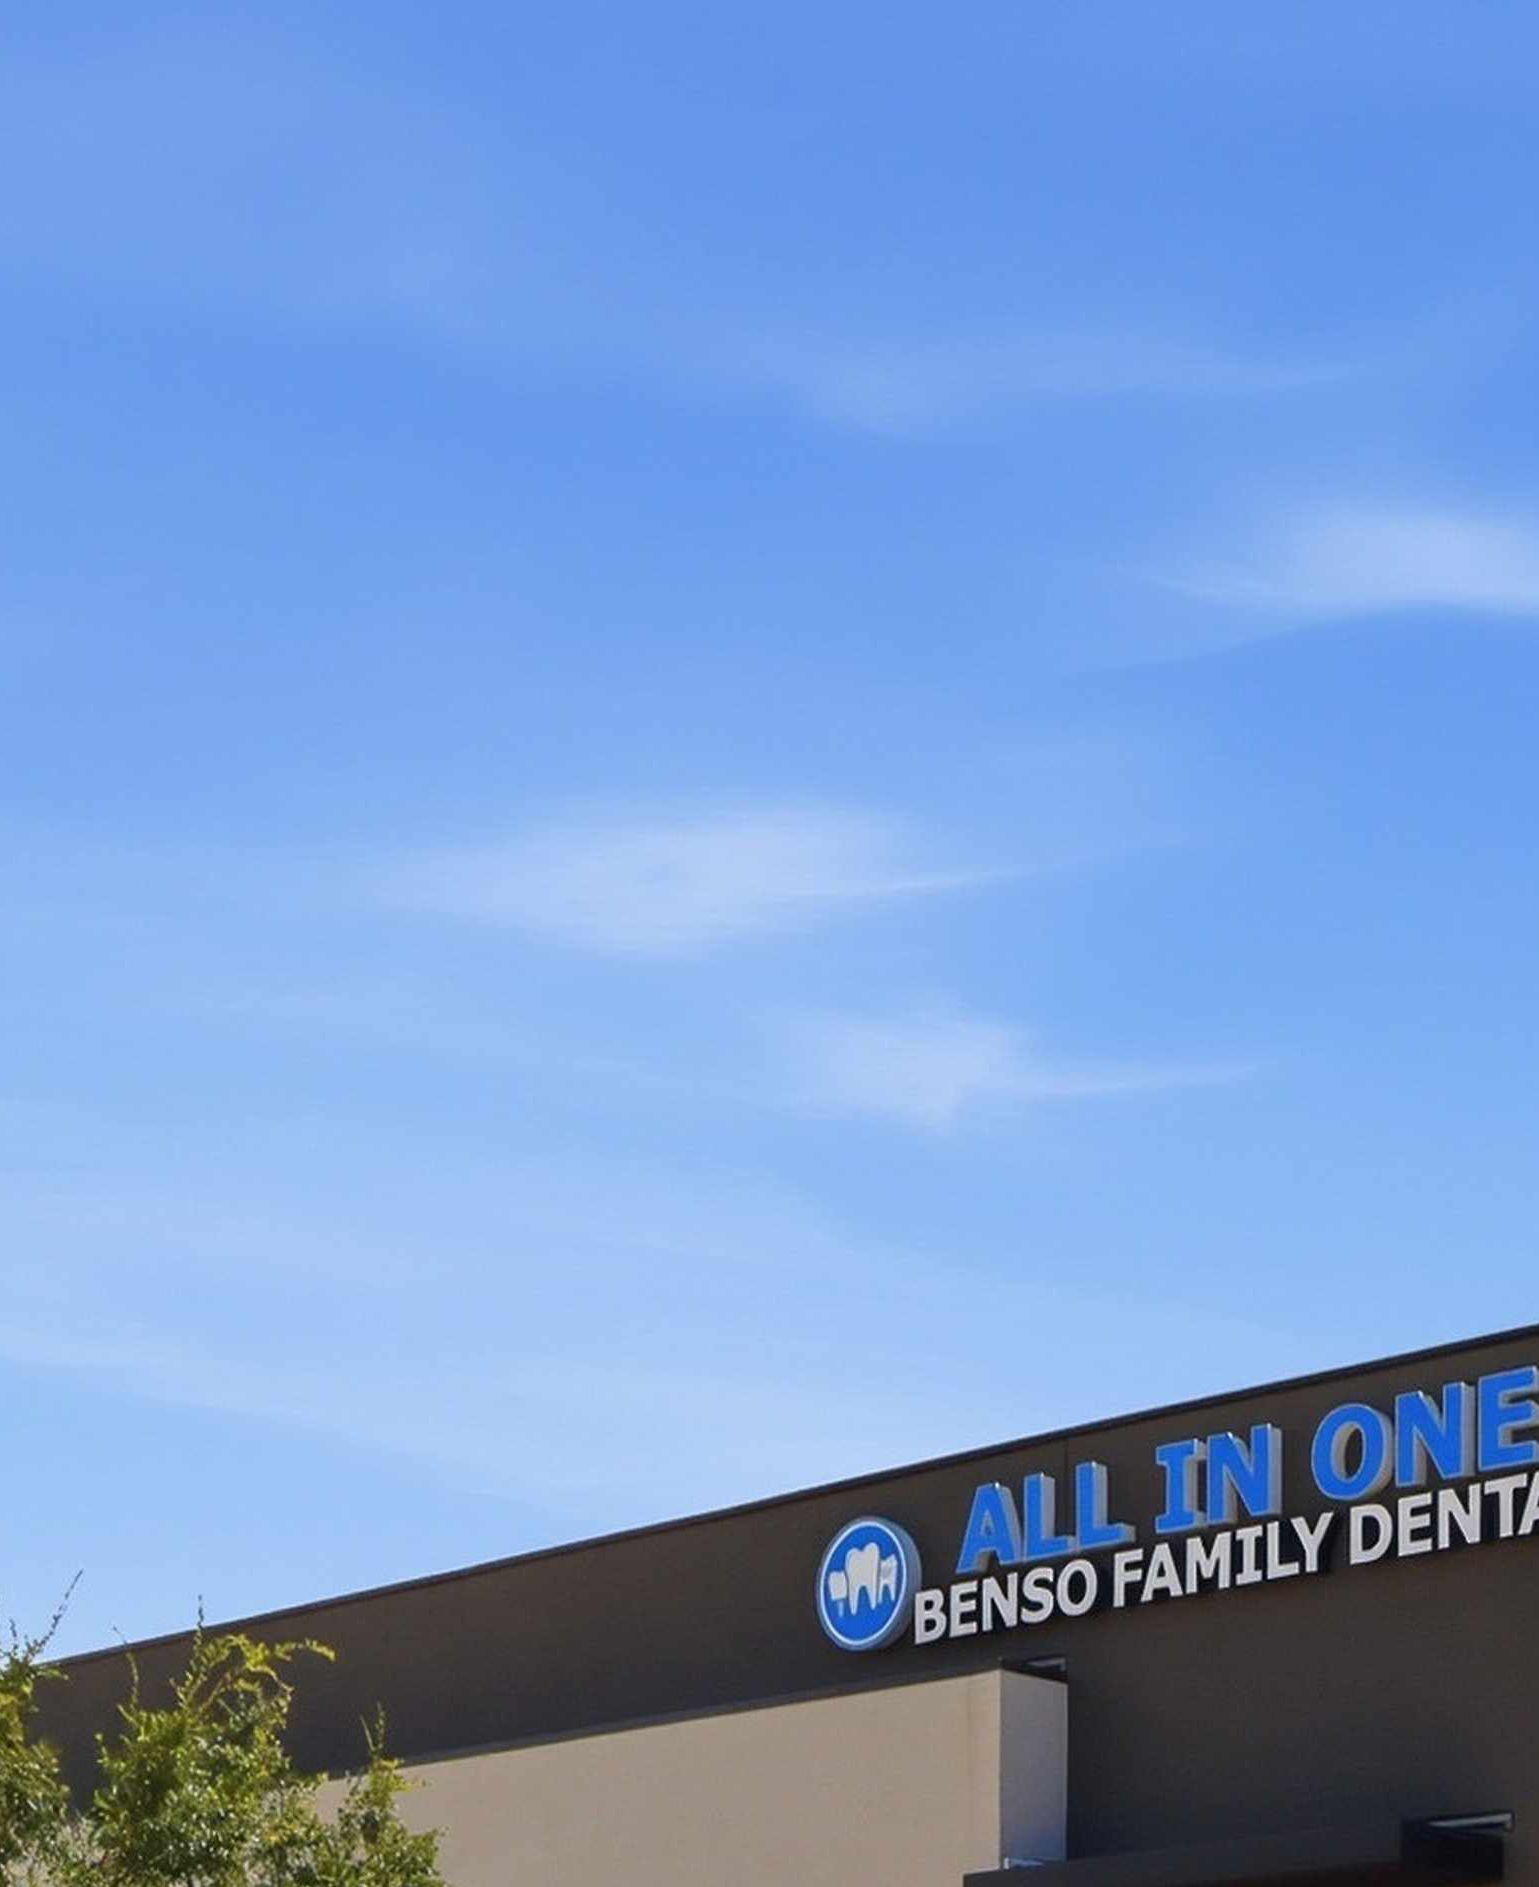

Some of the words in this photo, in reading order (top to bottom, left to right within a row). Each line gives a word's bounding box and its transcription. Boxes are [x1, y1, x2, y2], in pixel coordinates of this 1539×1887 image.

[956, 1461, 1136, 1574] ALL
[1155, 1423, 1282, 1534] IN
[914, 1559, 1098, 1646] BENSO
[1112, 1512, 1334, 1608] FAMILY
